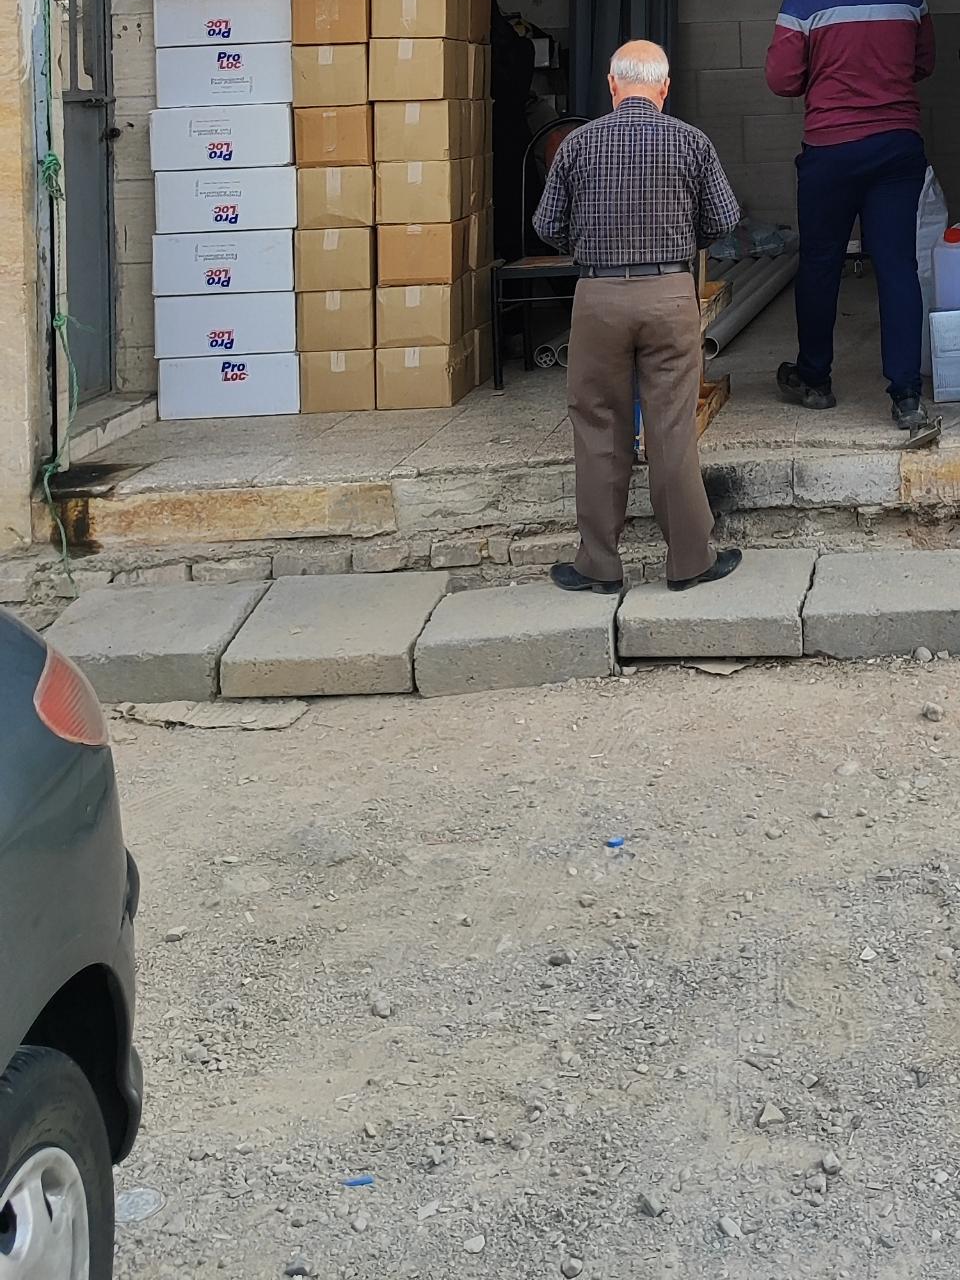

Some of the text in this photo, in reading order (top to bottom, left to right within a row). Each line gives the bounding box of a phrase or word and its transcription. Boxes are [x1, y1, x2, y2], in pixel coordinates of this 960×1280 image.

[208, 28, 231, 38] Pro
[217, 52, 240, 62] Pro
[208, 150, 232, 161] Pro
[214, 214, 238, 224] Pro
[206, 277, 231, 287] Pro
[209, 339, 234, 349] Pro
[221, 361, 245, 372] Pro
